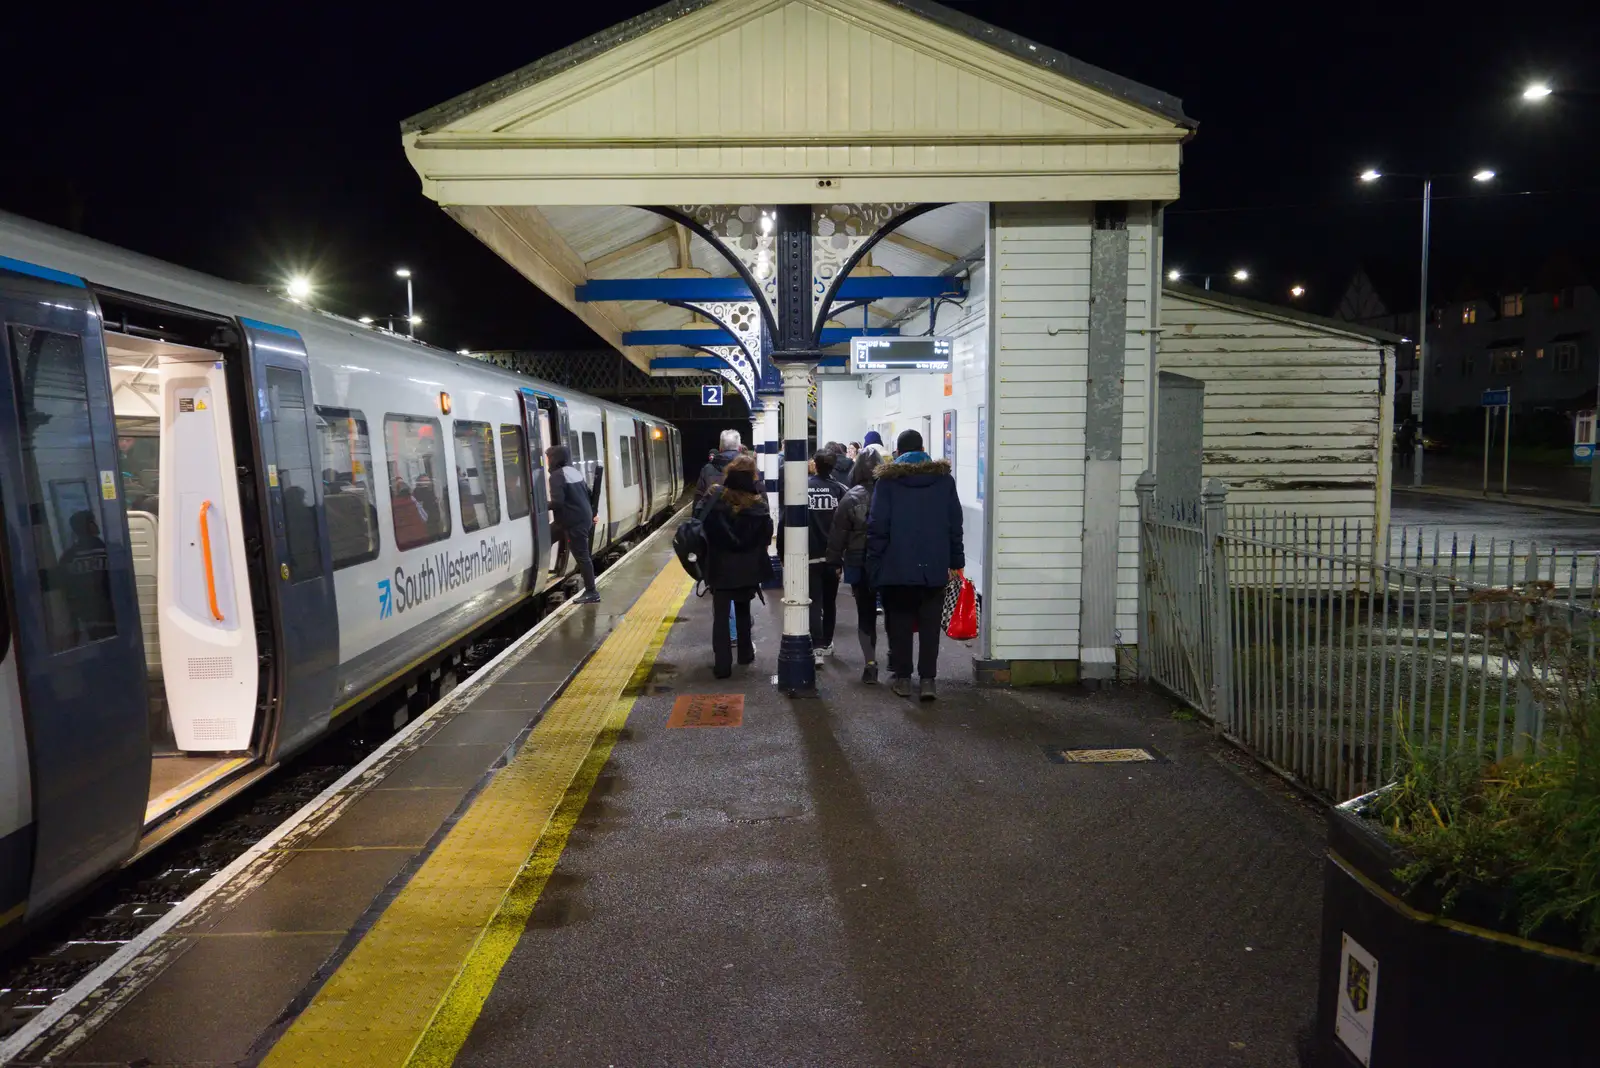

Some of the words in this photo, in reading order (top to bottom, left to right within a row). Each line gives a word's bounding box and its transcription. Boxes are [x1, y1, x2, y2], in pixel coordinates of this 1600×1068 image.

[859, 350, 866, 359] 2
[707, 387, 718, 403] 2
[394, 557, 436, 614] South
[434, 551, 481, 595] Western
[480, 535, 512, 575] Railway
